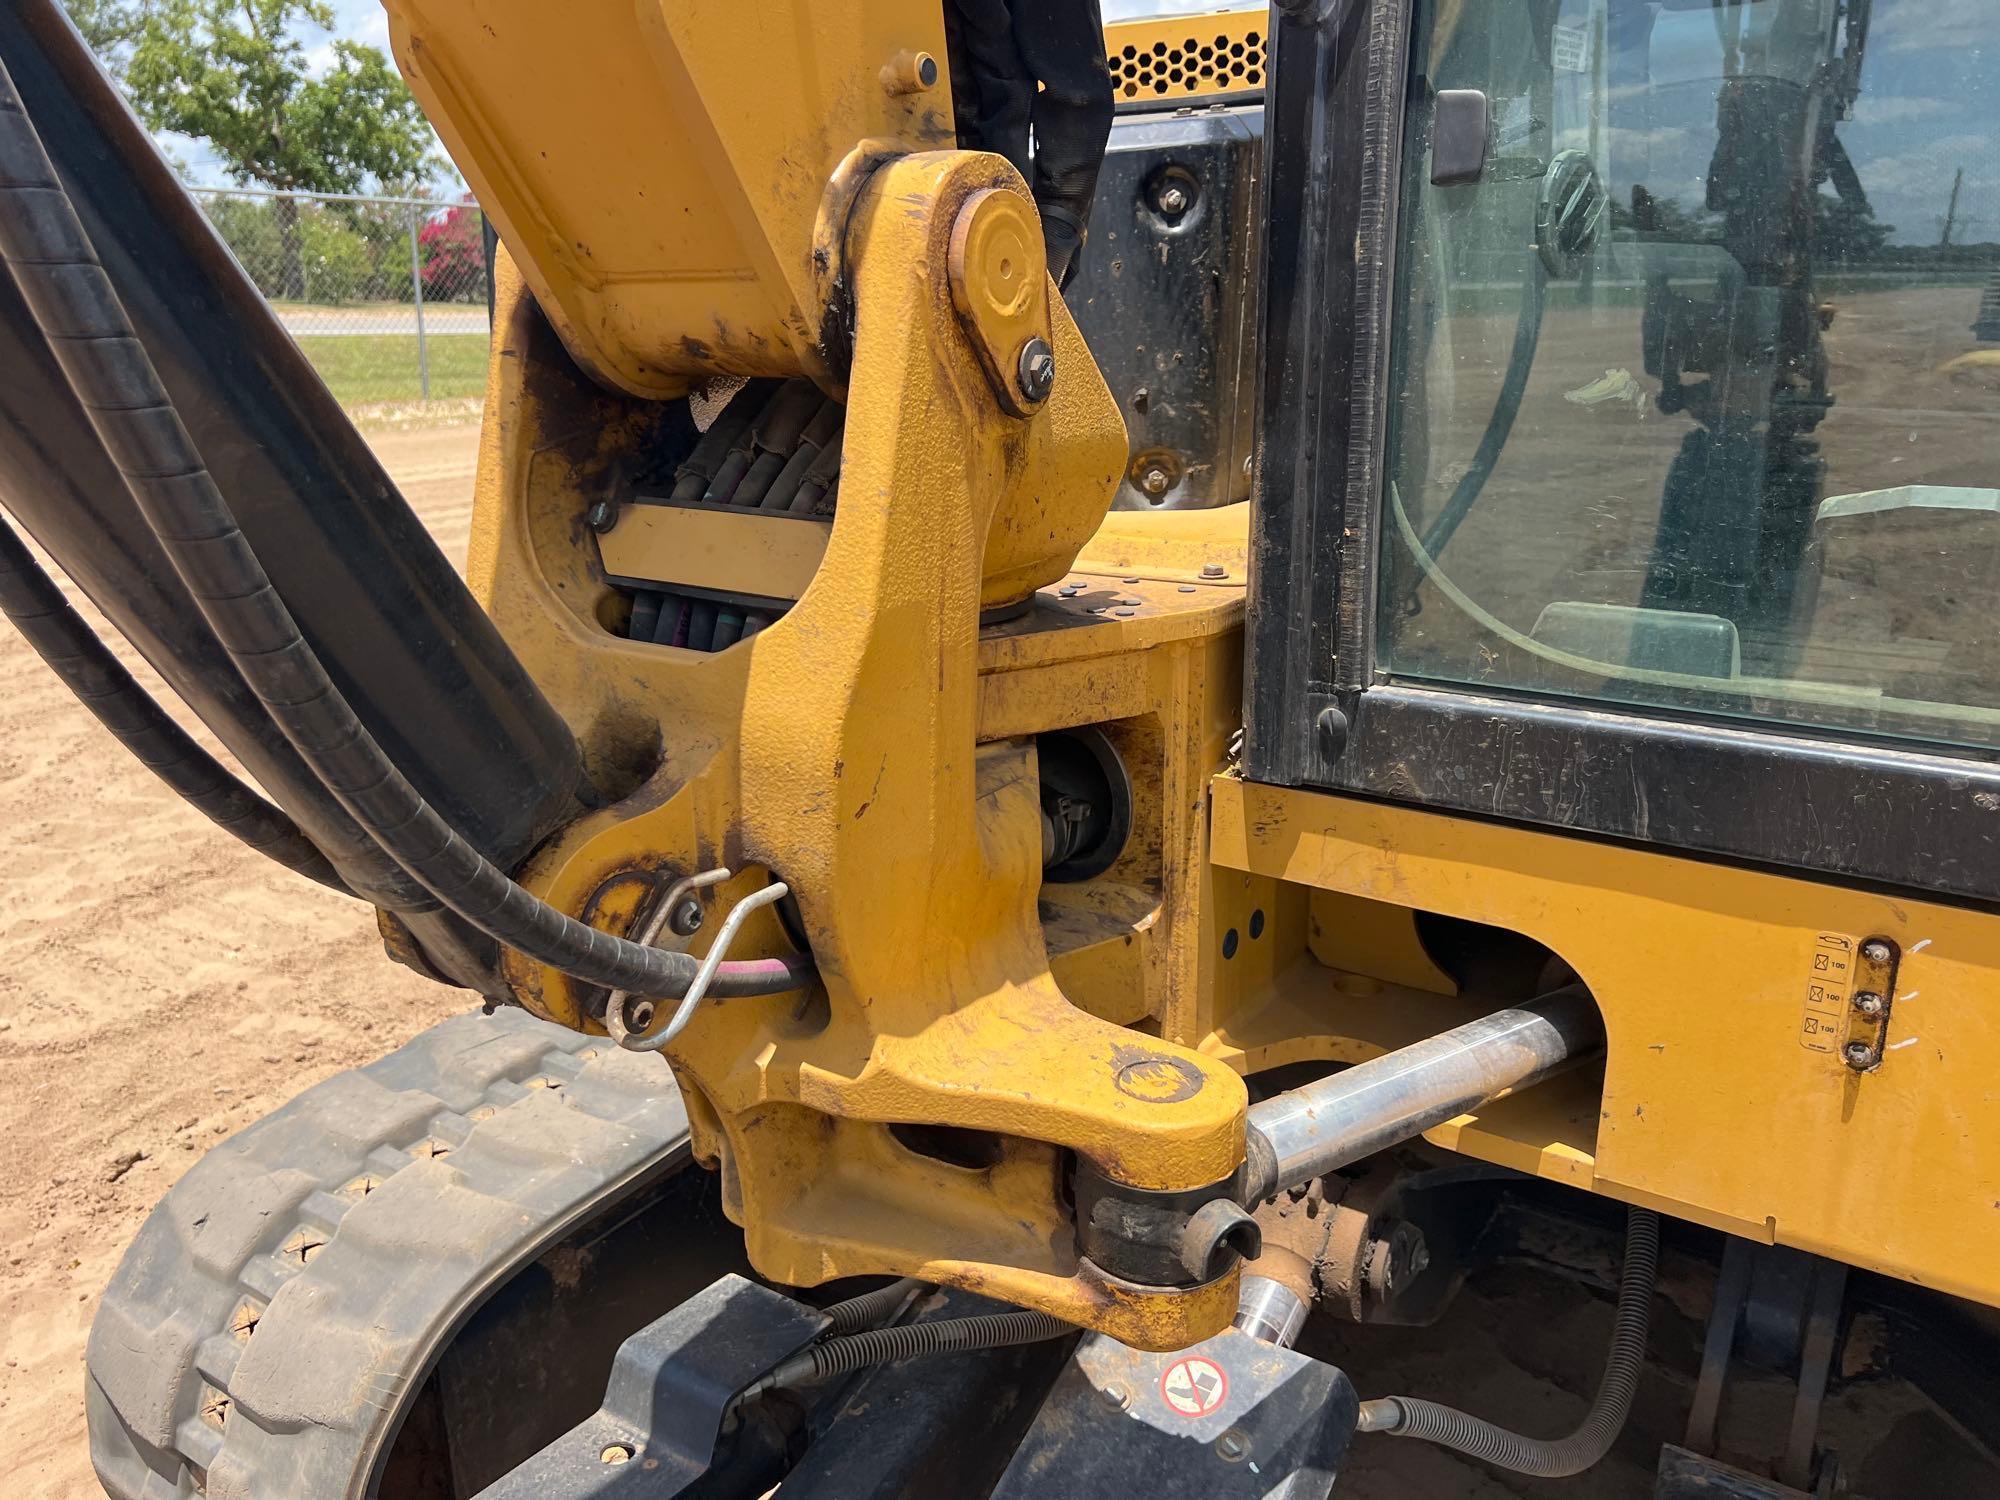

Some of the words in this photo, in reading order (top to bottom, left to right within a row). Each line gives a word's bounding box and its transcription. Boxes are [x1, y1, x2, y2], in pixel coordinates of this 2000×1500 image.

[1831, 961, 1845, 969] 100
[1826, 993, 1840, 1001] 100
[1820, 1025, 1834, 1033] 100
